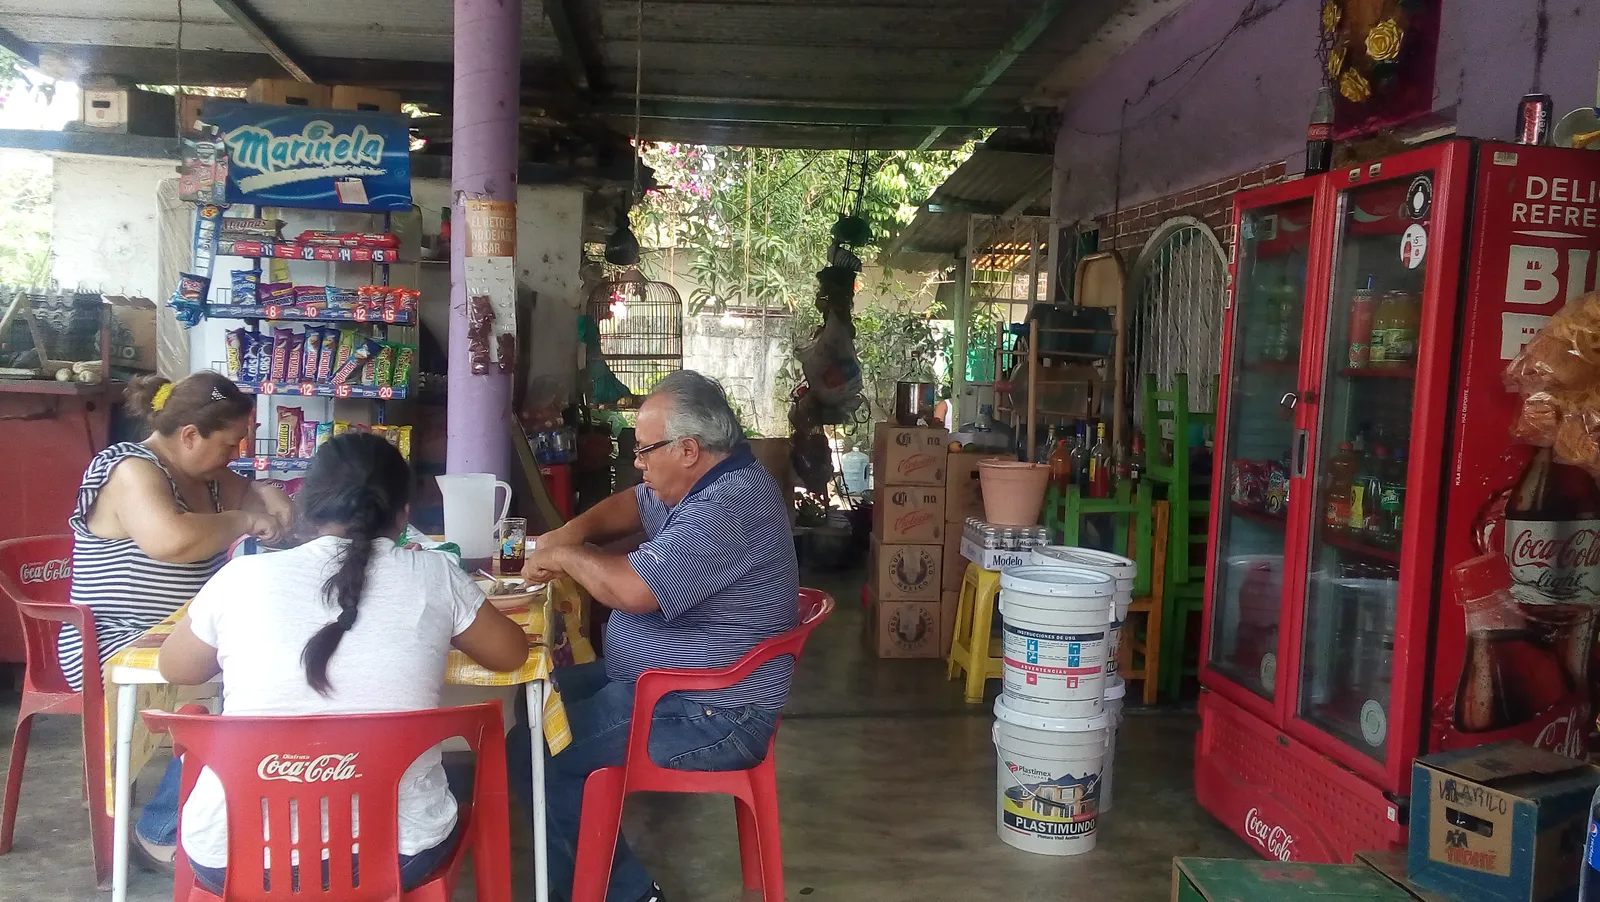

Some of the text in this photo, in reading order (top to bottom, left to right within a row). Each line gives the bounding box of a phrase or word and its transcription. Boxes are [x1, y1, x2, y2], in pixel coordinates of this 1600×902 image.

[1538, 110, 1546, 133] zero
[225, 121, 385, 173] Marinela
[1526, 175, 1600, 204] DELI
[1512, 202, 1600, 227] REFRE
[1505, 244, 1600, 304] BI
[992, 554, 1023, 567] Modelo
[1511, 528, 1600, 569] Coca-Cola
[20, 558, 73, 584] Coca-Cola
[1537, 568, 1589, 590] light
[1017, 629, 1055, 640] INSTRUCCIONES
[1021, 664, 1067, 675] ADVERTENCIAS
[257, 751, 360, 783] Coca-Cola
[1019, 765, 1052, 778] Plastimex
[1016, 816, 1095, 834] PLASTIMUNDO
[1245, 807, 1294, 862] Coca-Cola
